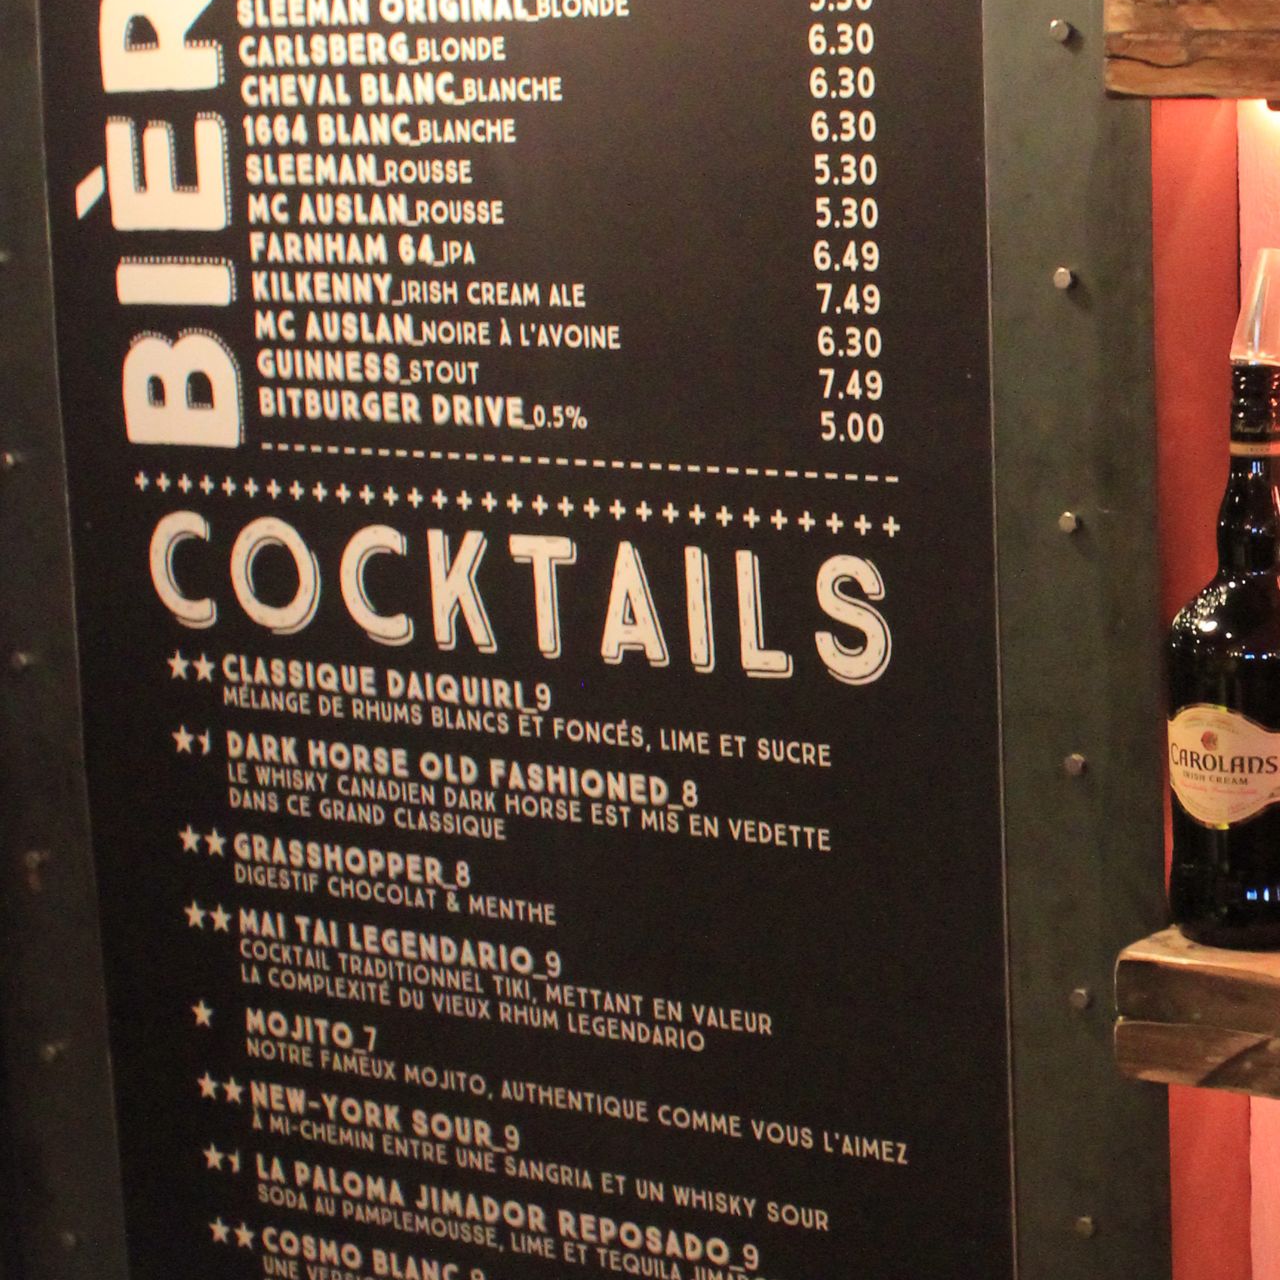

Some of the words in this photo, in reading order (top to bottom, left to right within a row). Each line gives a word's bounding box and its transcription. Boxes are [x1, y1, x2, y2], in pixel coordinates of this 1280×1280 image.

[808, 23, 874, 55] 6.30
[241, 75, 350, 107] CHEVAL
[809, 67, 875, 98] 6.30
[243, 114, 308, 146] 1664
[247, 193, 288, 223] MC
[814, 198, 877, 228] 5.30
[249, 232, 387, 263] FARNHAM
[812, 240, 879, 271] 6.49
[467, 282, 539, 306] CREAM
[549, 283, 585, 308] ALE
[816, 283, 880, 315] 7.49
[521, 323, 621, 349] L'AVOINE
[817, 327, 882, 358] 6.30
[819, 369, 883, 400] 7.49
[259, 387, 421, 422] BITBURGER
[820, 412, 884, 444] 5.00
[149, 510, 893, 685] COCKTAILS
[222, 654, 376, 696] CLASSIQUE
[224, 680, 311, 715] MÉLANGE
[318, 695, 343, 717] DE
[353, 698, 422, 726] RHUMS
[431, 706, 509, 734] BLANCS
[519, 714, 543, 738] ET
[660, 728, 710, 755] LIME
[720, 734, 746, 758] ET
[758, 738, 831, 767] SUCRE
[227, 729, 299, 766] DARK
[308, 738, 409, 779] HORSE
[420, 751, 478, 786] OLD
[1170, 743, 1279, 774] CAROLANS
[1209, 774, 1249, 786] CREAM
[320, 797, 385, 826] GRAND
[394, 807, 506, 841] CLASSIQUE
[338, 775, 435, 806] CANADIEN
[729, 818, 831, 851] VEDETTE
[234, 862, 319, 893] DIGESTIF
[327, 876, 437, 911] CHOCOLAT
[469, 895, 556, 926] MENTHE
[240, 907, 286, 939] MAI
[295, 916, 339, 948] TAI
[692, 1004, 772, 1036] VALEUR
[250, 1080, 401, 1132] NEW-YORK
[502, 1080, 648, 1122] AUTHENTIQUE
[658, 1104, 741, 1137] COMME
[751, 1120, 813, 1150] VOUS
[824, 1131, 908, 1165] L'AIMEZ
[295, 1160, 404, 1207] PALOMA
[416, 1184, 546, 1234] JIMADOR
[673, 1184, 756, 1218] WHISKY
[767, 1202, 829, 1232] SOUR
